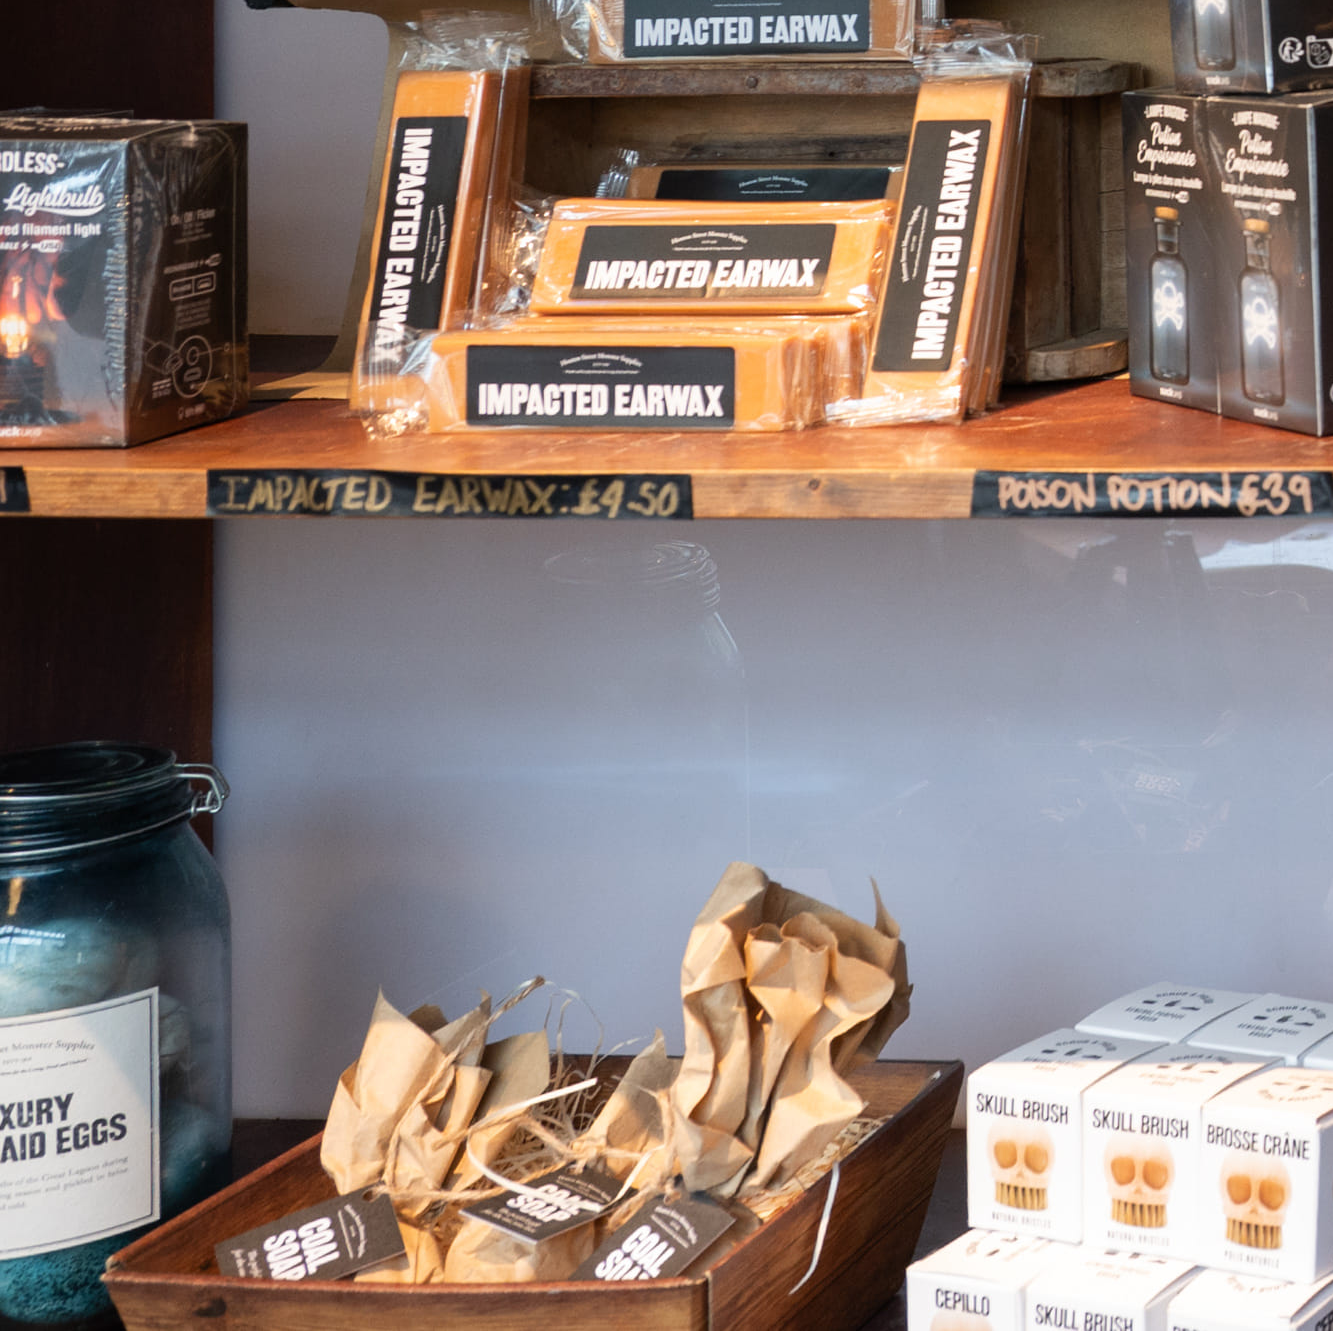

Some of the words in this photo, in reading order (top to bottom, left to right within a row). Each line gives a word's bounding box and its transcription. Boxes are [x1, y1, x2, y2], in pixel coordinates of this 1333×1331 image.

[635, 17, 753, 47] IMPACTED
[760, 14, 858, 44] EARWAX
[1150, 122, 1182, 146] Potion
[1239, 130, 1272, 155] Potion
[0, 150, 65, 174] DLESS-
[389, 128, 432, 252] IMPACTED
[935, 129, 981, 230] EARWAX
[3, 182, 106, 216] Lightbulb
[22, 223, 70, 236] filament
[74, 223, 101, 238] light
[584, 260, 710, 289] IMPACTED
[712, 258, 820, 288] EARWAX
[910, 236, 962, 360] IMPACTED
[478, 383, 608, 416] IMPACTED
[614, 384, 724, 417] EARWAX
[219, 476, 392, 512] IMPACTED
[998, 474, 1096, 512] POISON
[1107, 473, 1230, 512] POTION
[1237, 473, 1312, 516] £39
[0, 1092, 74, 1131] XURY
[976, 1092, 1018, 1118] SKULL
[1022, 1100, 1068, 1124] BRUSH
[1092, 1108, 1136, 1133] SKULL
[1140, 1116, 1189, 1139] BRUSH
[56, 1112, 127, 1155] EGGS
[1206, 1124, 1259, 1152] BROSSE
[1263, 1131, 1310, 1160] CRÂNE
[506, 1195, 572, 1222] SOAP
[264, 1230, 306, 1280] SOAP
[298, 1217, 340, 1275] COAL
[622, 1225, 675, 1278] COAL
[934, 1288, 990, 1316] CEPILLO
[1036, 1304, 1080, 1330] SKULL
[1084, 1312, 1134, 1331] BRUSH
